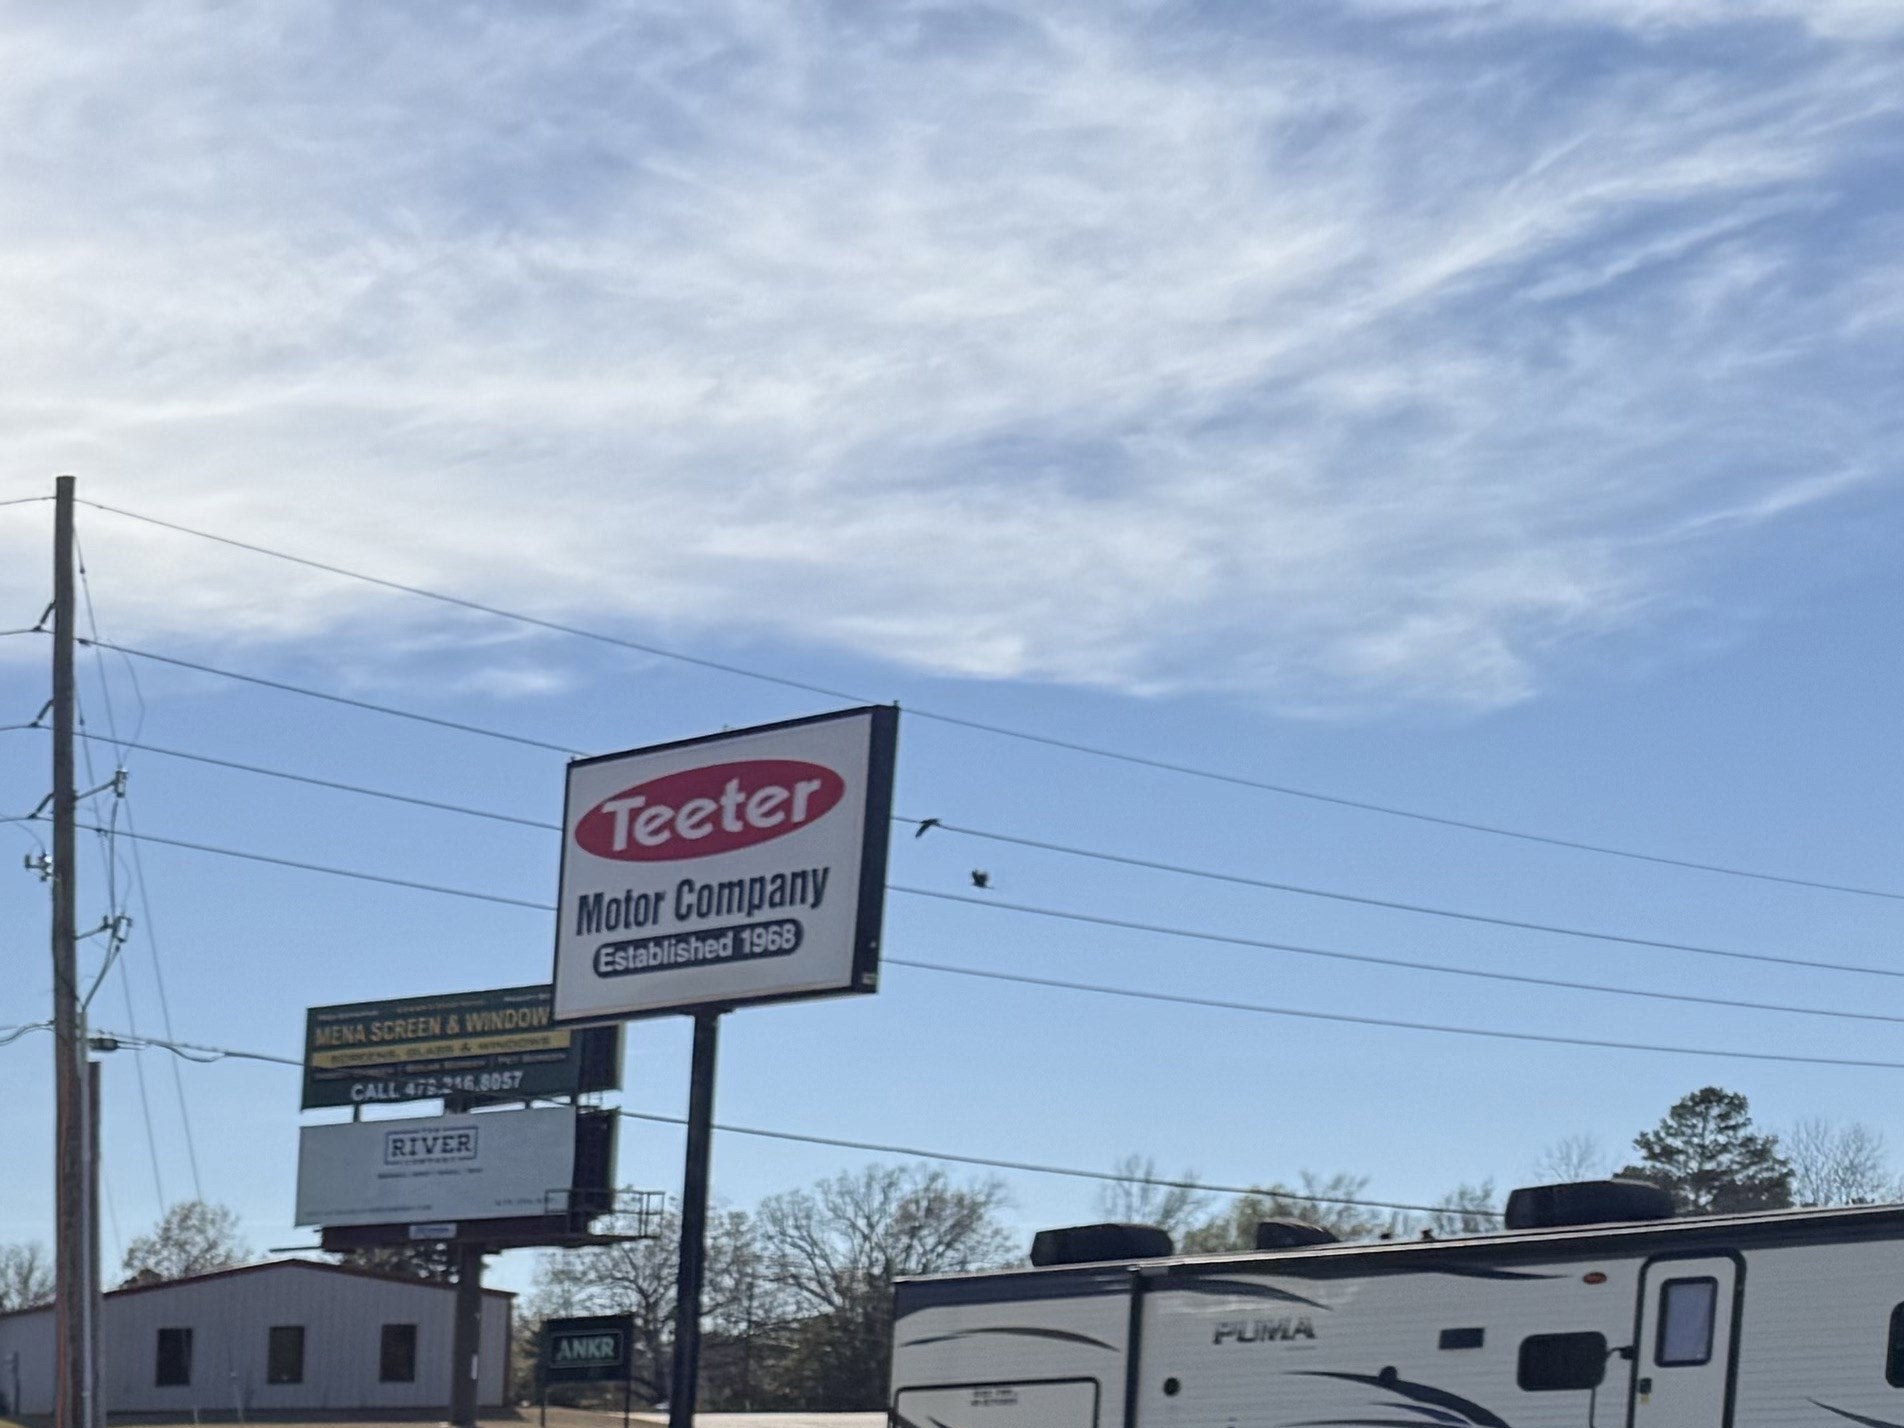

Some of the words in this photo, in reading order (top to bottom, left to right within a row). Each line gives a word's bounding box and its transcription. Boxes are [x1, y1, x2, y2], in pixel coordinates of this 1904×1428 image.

[602, 779, 821, 850] Teeter
[576, 889, 666, 936] Motor
[674, 867, 830, 921] Company
[598, 930, 732, 972] Established
[741, 923, 796, 955] 1968
[316, 1024, 366, 1046] MENA
[371, 1015, 441, 1041] SCREEN
[447, 1013, 459, 1034] &
[350, 1082, 400, 1101] CALL
[391, 1133, 471, 1157] RIVER
[1212, 1317, 1316, 1345] PUMA
[555, 1335, 615, 1361] ANKR
